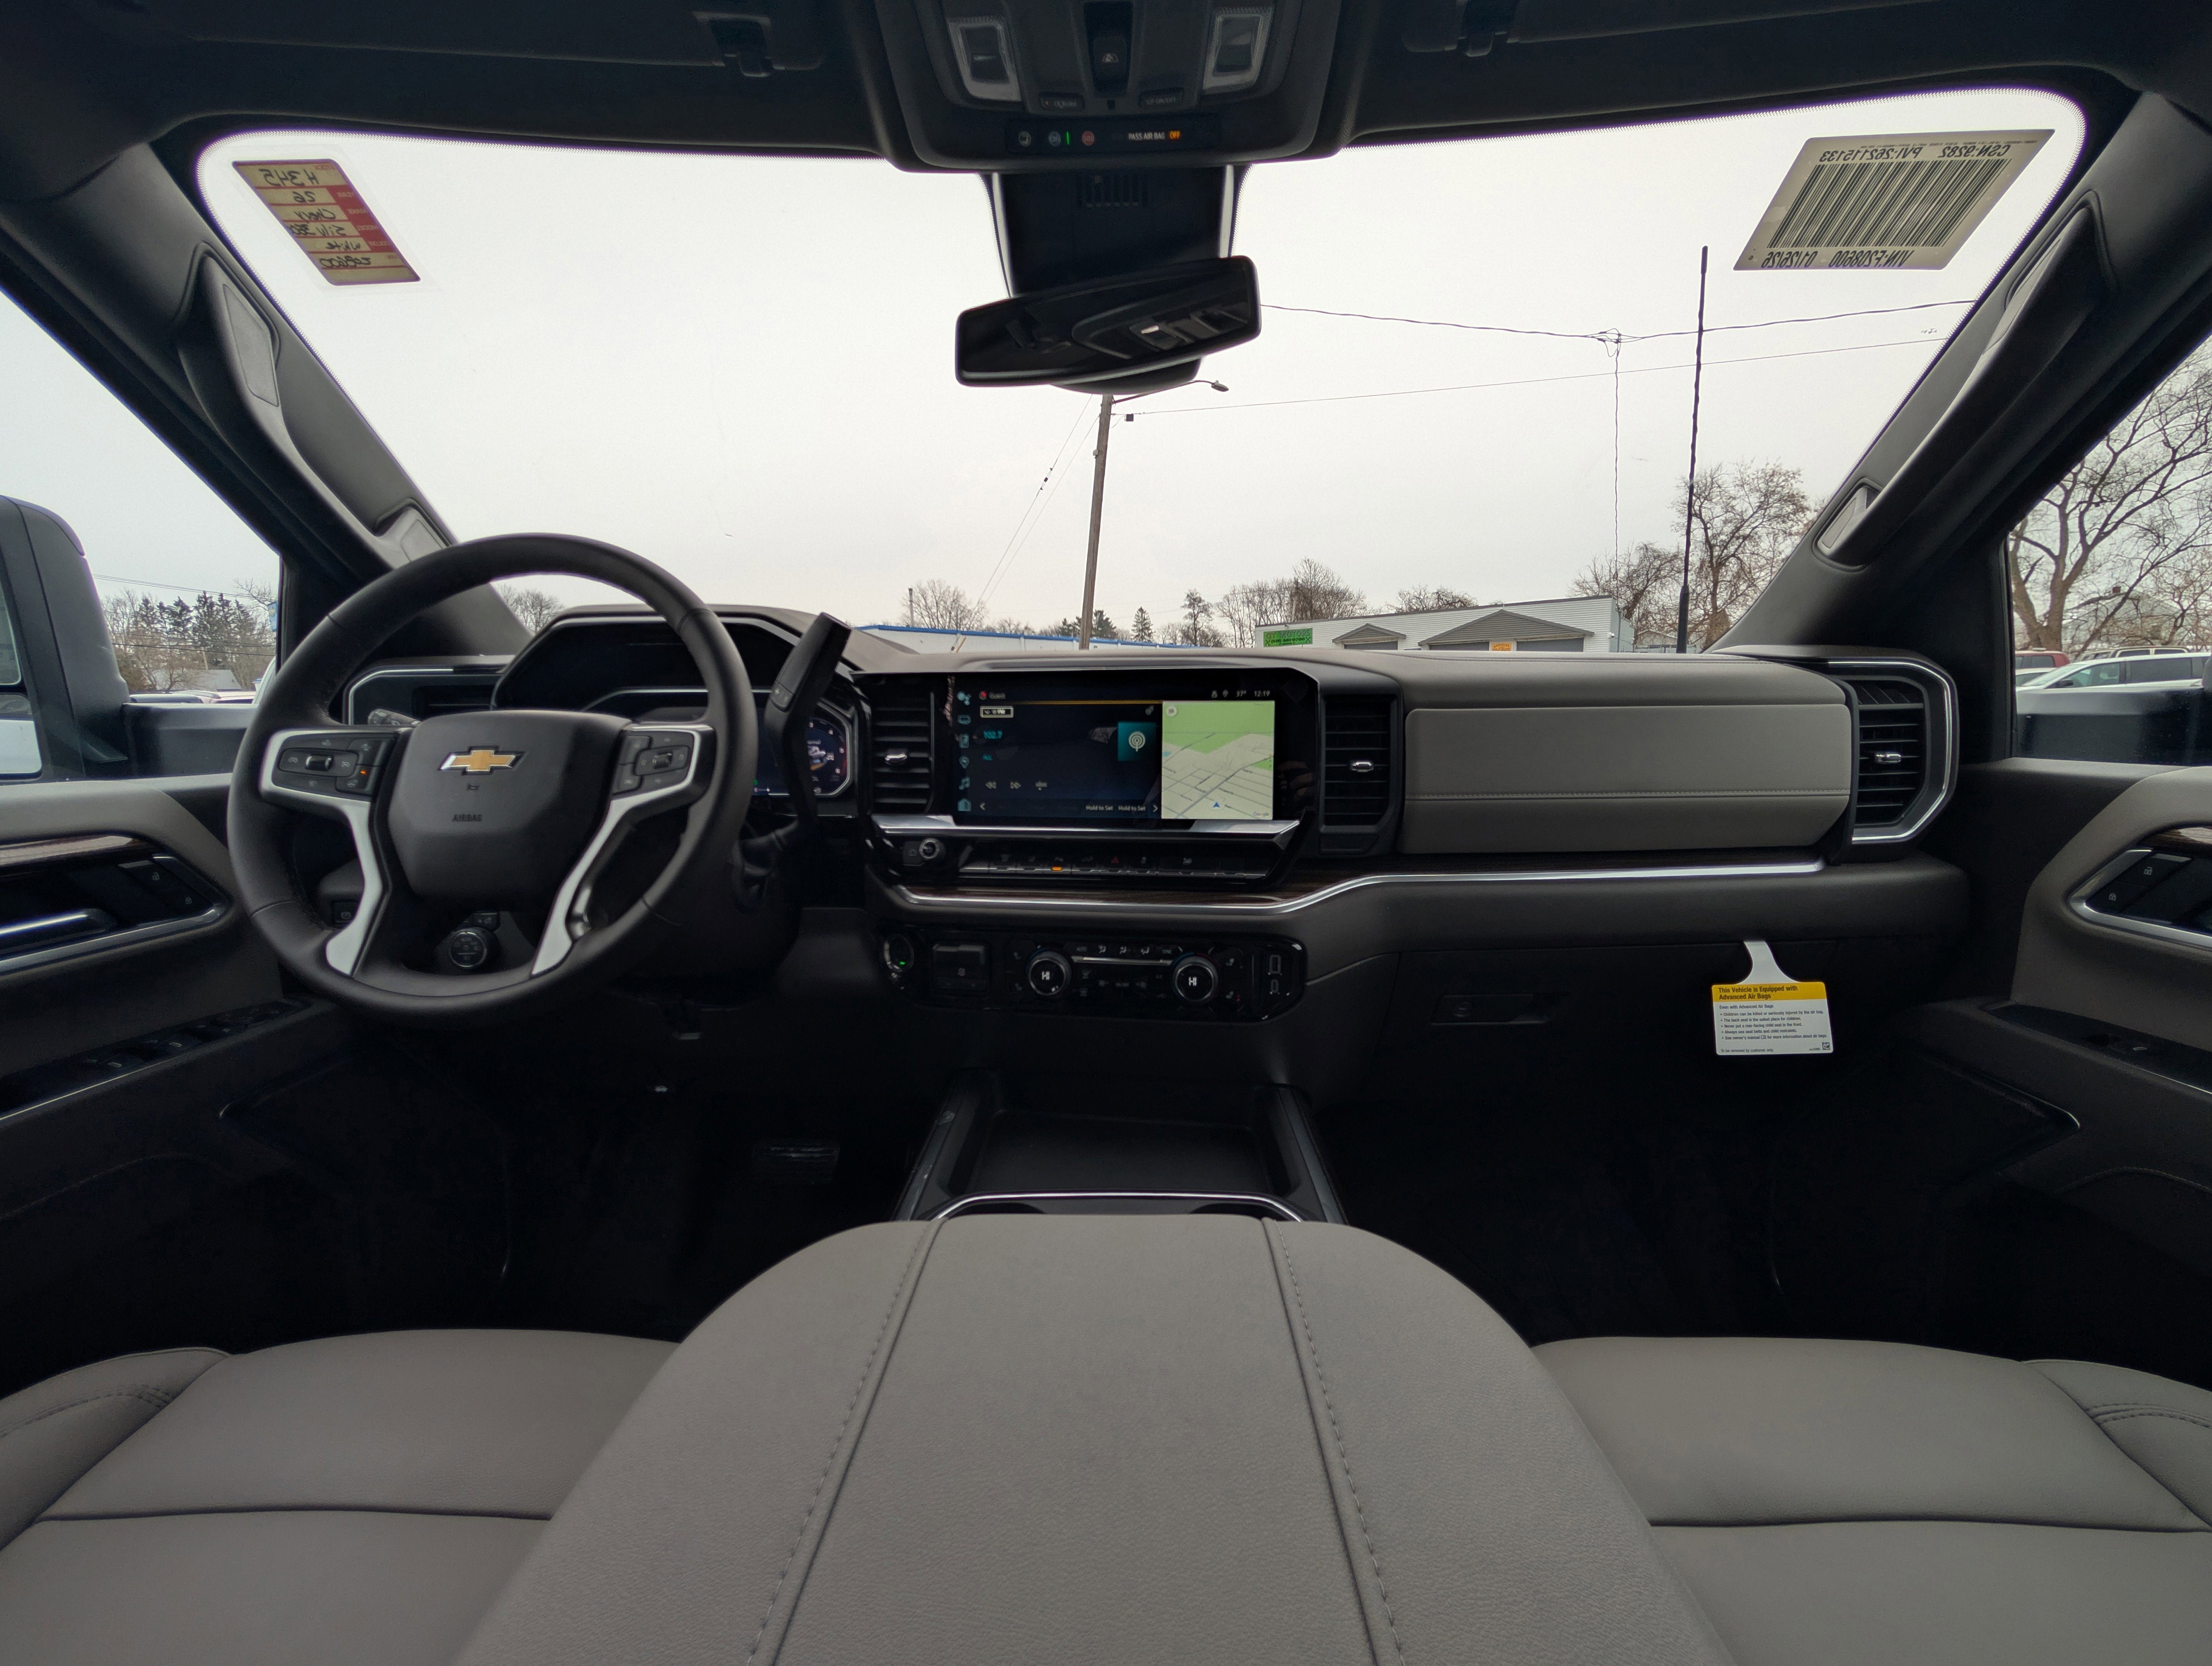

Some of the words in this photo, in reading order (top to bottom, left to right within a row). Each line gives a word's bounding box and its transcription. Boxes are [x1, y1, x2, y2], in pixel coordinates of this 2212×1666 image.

[1279, 629, 1311, 638] MOTORS
[1042, 971, 1050, 980] HI
[1189, 977, 1196, 986] HI
